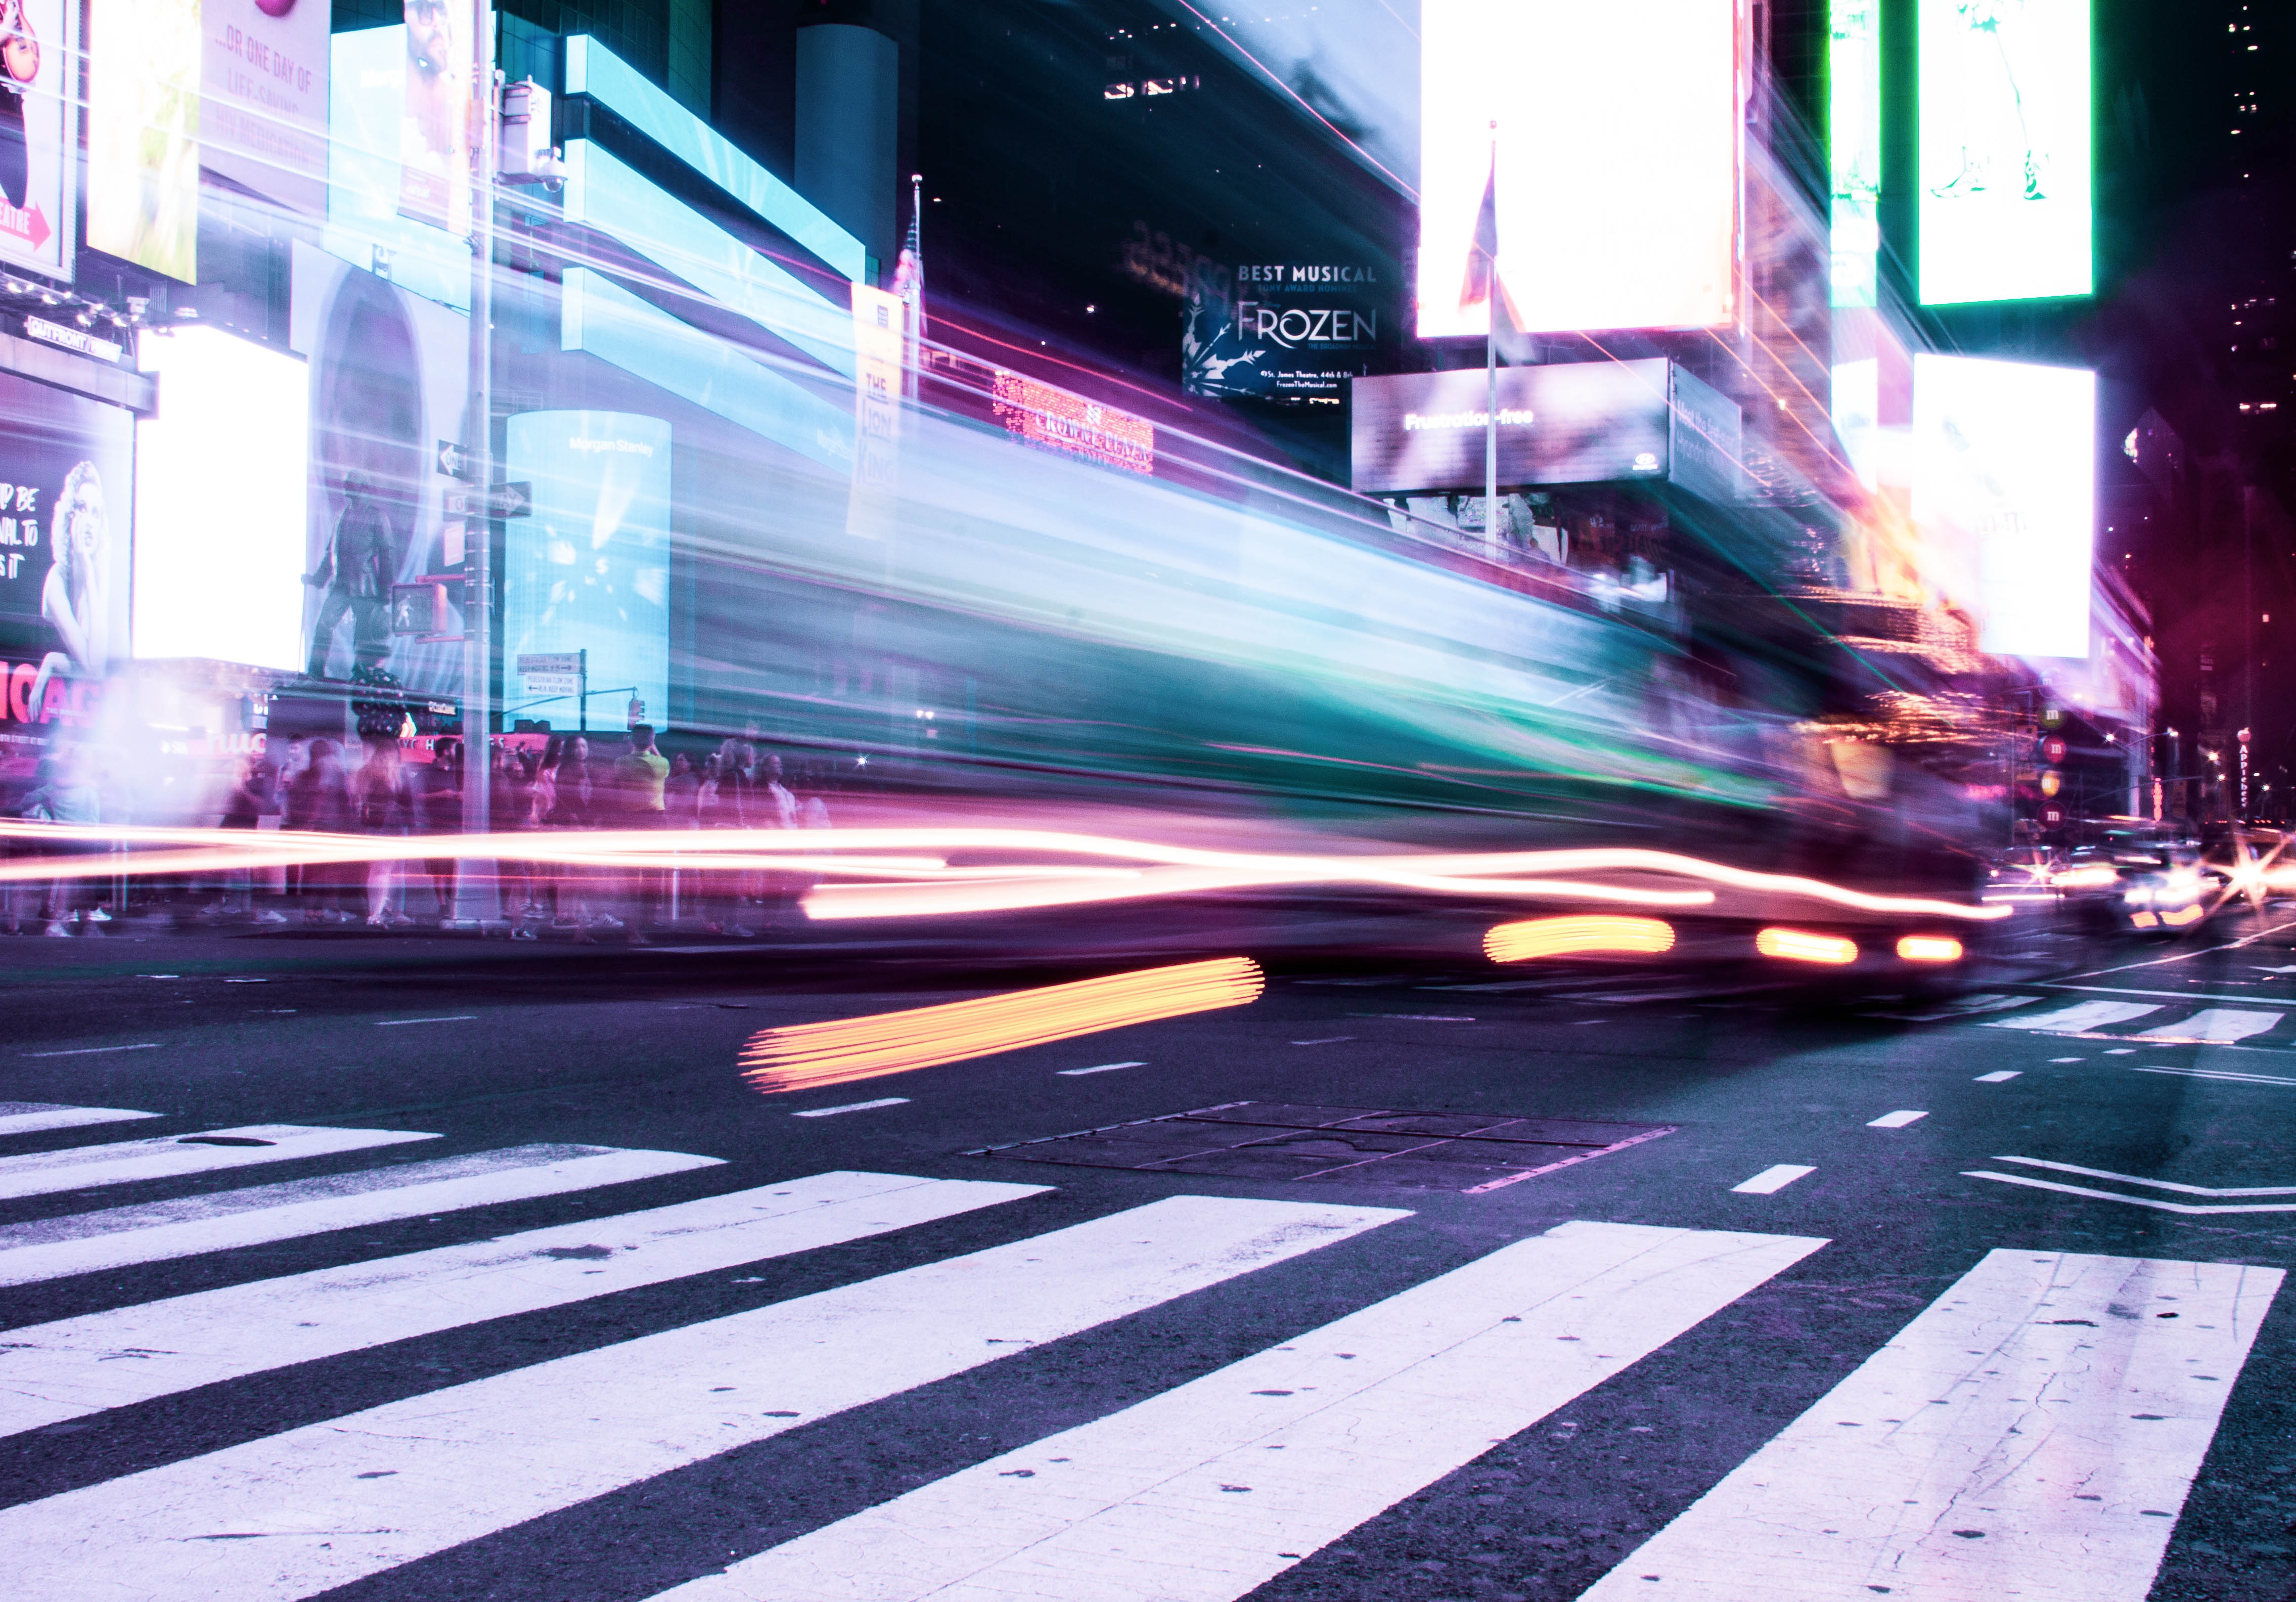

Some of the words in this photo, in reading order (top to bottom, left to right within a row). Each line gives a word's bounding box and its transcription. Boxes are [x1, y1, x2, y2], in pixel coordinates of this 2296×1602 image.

[215, 24, 243, 57] ...OR
[247, 36, 269, 72] ONE
[274, 51, 294, 85] DAY
[298, 66, 312, 95] OF
[1239, 265, 1285, 282] BEST
[1292, 265, 1377, 283] MUSICAL
[1258, 284, 1281, 292] TONY
[1284, 284, 1315, 293] AWARD
[1318, 284, 1357, 293] NOMINEE
[1238, 301, 1376, 349] FROZEN
[866, 372, 886, 399] THE
[1277, 380, 1337, 389] FrozenTheMusical.com
[1036, 411, 1099, 447] CROWNE
[569, 436, 615, 453] Morgan
[616, 439, 654, 458] Stanley
[16, 485, 41, 512] BE
[21, 519, 38, 547] TO
[8, 553, 26, 580] IT
